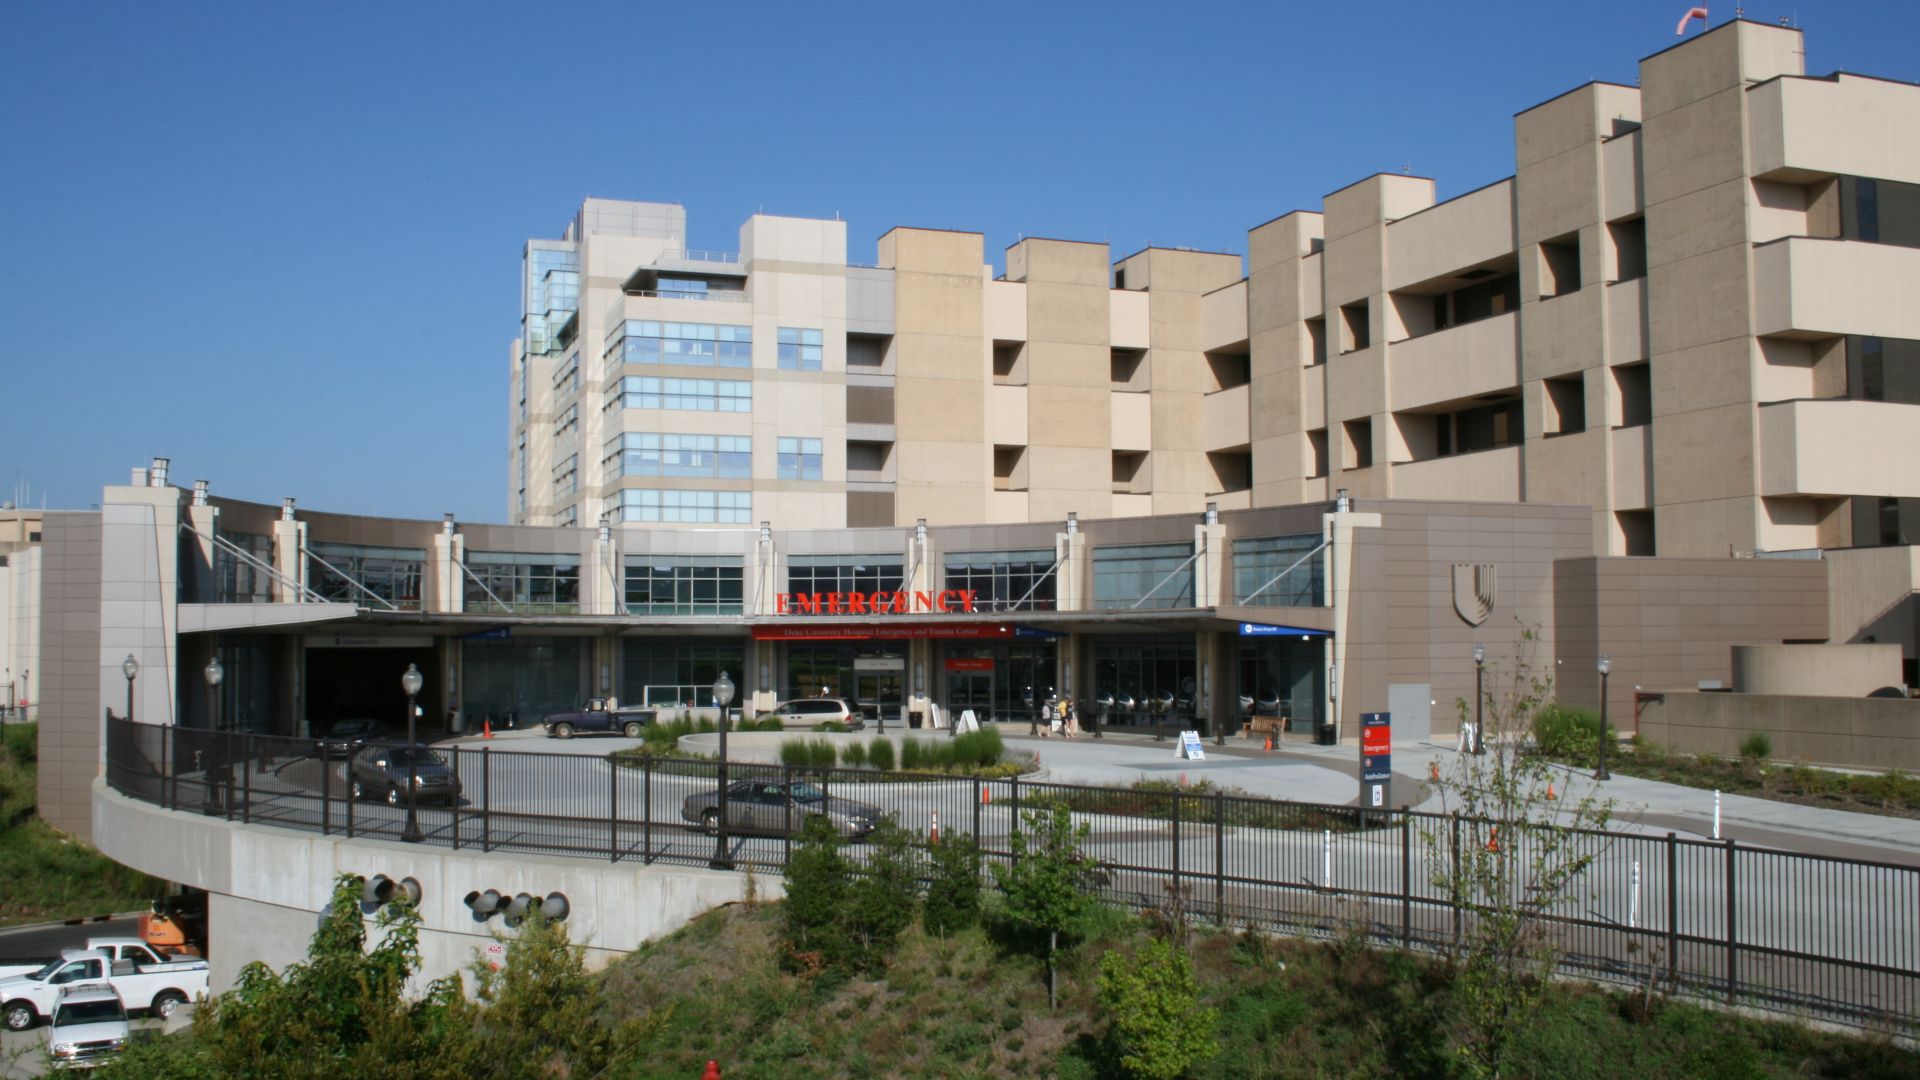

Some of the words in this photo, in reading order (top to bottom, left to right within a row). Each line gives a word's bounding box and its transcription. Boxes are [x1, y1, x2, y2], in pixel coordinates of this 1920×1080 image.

[776, 590, 977, 613] EMERGENCY
[806, 628, 842, 637] University
[843, 628, 874, 637] Hospital
[875, 628, 912, 637] Emergency
[914, 627, 927, 635] and
[928, 627, 955, 635] Trauma
[955, 626, 979, 635] Center
[1364, 744, 1388, 752] Emergency
